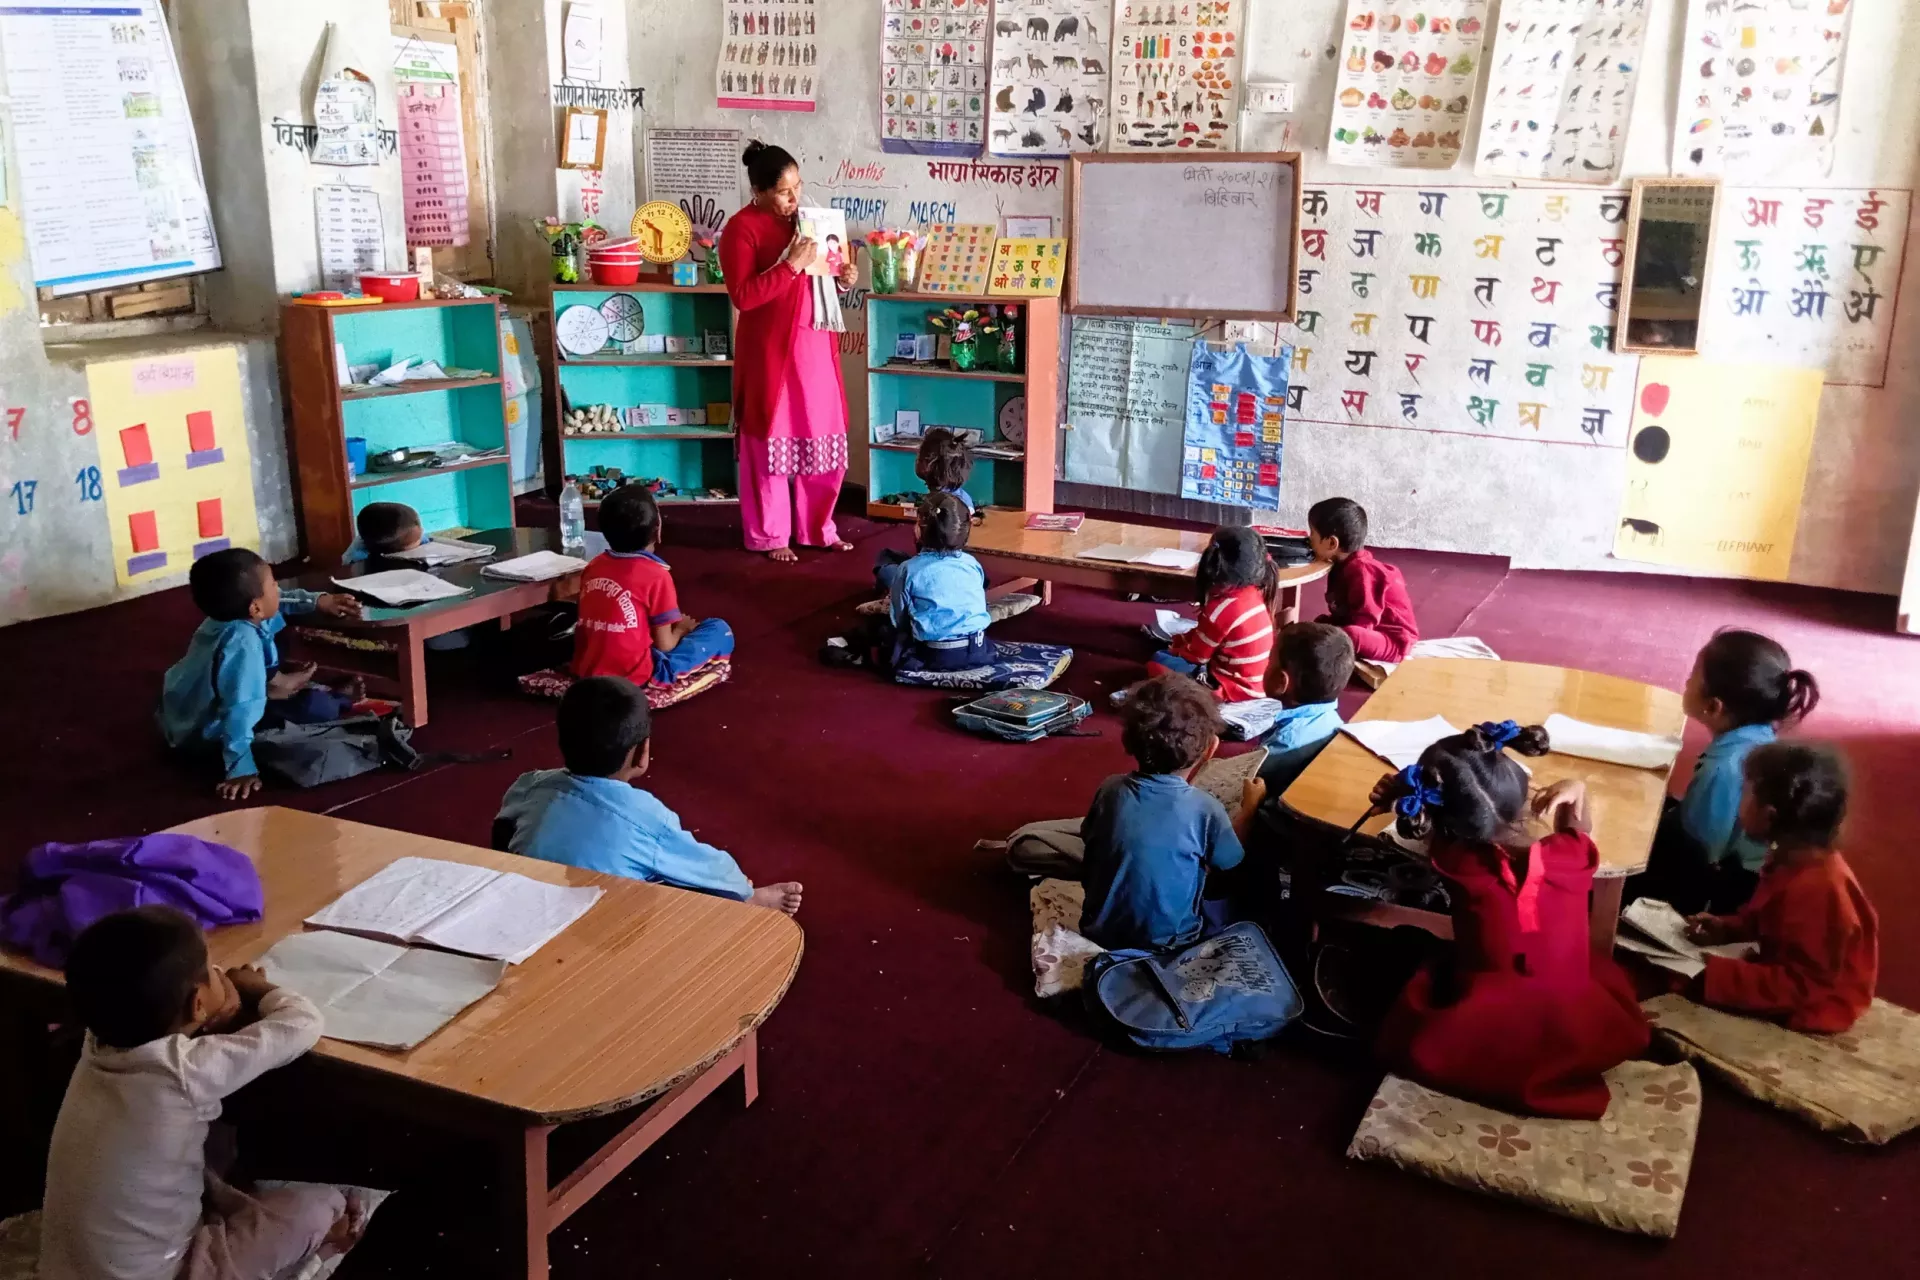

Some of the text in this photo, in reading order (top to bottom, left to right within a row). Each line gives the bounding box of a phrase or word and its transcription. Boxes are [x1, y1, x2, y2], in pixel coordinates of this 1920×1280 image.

[1125, 5, 1189, 18] 3 4
[1122, 35, 1187, 47] 5 6
[1121, 65, 1186, 77] 7 8
[553, 77, 584, 107] गणित
[618, 80, 647, 112] क्षेत्र
[1120, 94, 1128, 106] 9
[271, 116, 319, 153] विज्ञा
[1117, 123, 1128, 135] 10
[828, 159, 885, 185] Months
[927, 161, 970, 187] भाषा
[1027, 159, 1061, 189] क्षेत्र
[908, 200, 957, 227] MARCH
[1302, 190, 1328, 223] क
[1356, 190, 1385, 218] ख
[1419, 192, 1449, 220] ग
[1477, 192, 1509, 220] घ
[1600, 196, 1631, 223] च
[1743, 196, 1783, 229] आ
[1855, 190, 1889, 235] ई
[1000, 244, 1011, 256] अ
[1301, 229, 1329, 261] छ
[1348, 229, 1384, 259] ज
[1414, 232, 1442, 260] झ
[1599, 237, 1625, 267] ठ
[1851, 244, 1885, 284] ए
[994, 273, 1009, 289] ओ
[1013, 259, 1024, 272] ऊ
[1031, 260, 1041, 274] ए
[1350, 272, 1377, 299] ढ
[1410, 274, 1441, 299] ण
[1474, 277, 1502, 309] त
[1531, 276, 1563, 305] थ
[1596, 282, 1621, 311] द
[1728, 278, 1770, 316] ओ
[1787, 279, 1831, 321] औ
[1351, 313, 1379, 336] न
[1404, 313, 1436, 345] प
[1470, 319, 1502, 347] फ
[1528, 322, 1560, 348] ब
[1345, 350, 1378, 380] य
[1405, 353, 1428, 386] र
[1468, 358, 1497, 388] ल
[1525, 363, 1555, 389] व
[1581, 363, 1613, 391] श
[6, 399, 93, 441] 7 8
[1287, 385, 1310, 415] ष
[1341, 390, 1371, 420] स
[1398, 392, 1423, 426] ह
[1466, 395, 1501, 429] क्ष
[9, 465, 102, 515] 17 18
[1716, 540, 1775, 555] ELEPHANT
